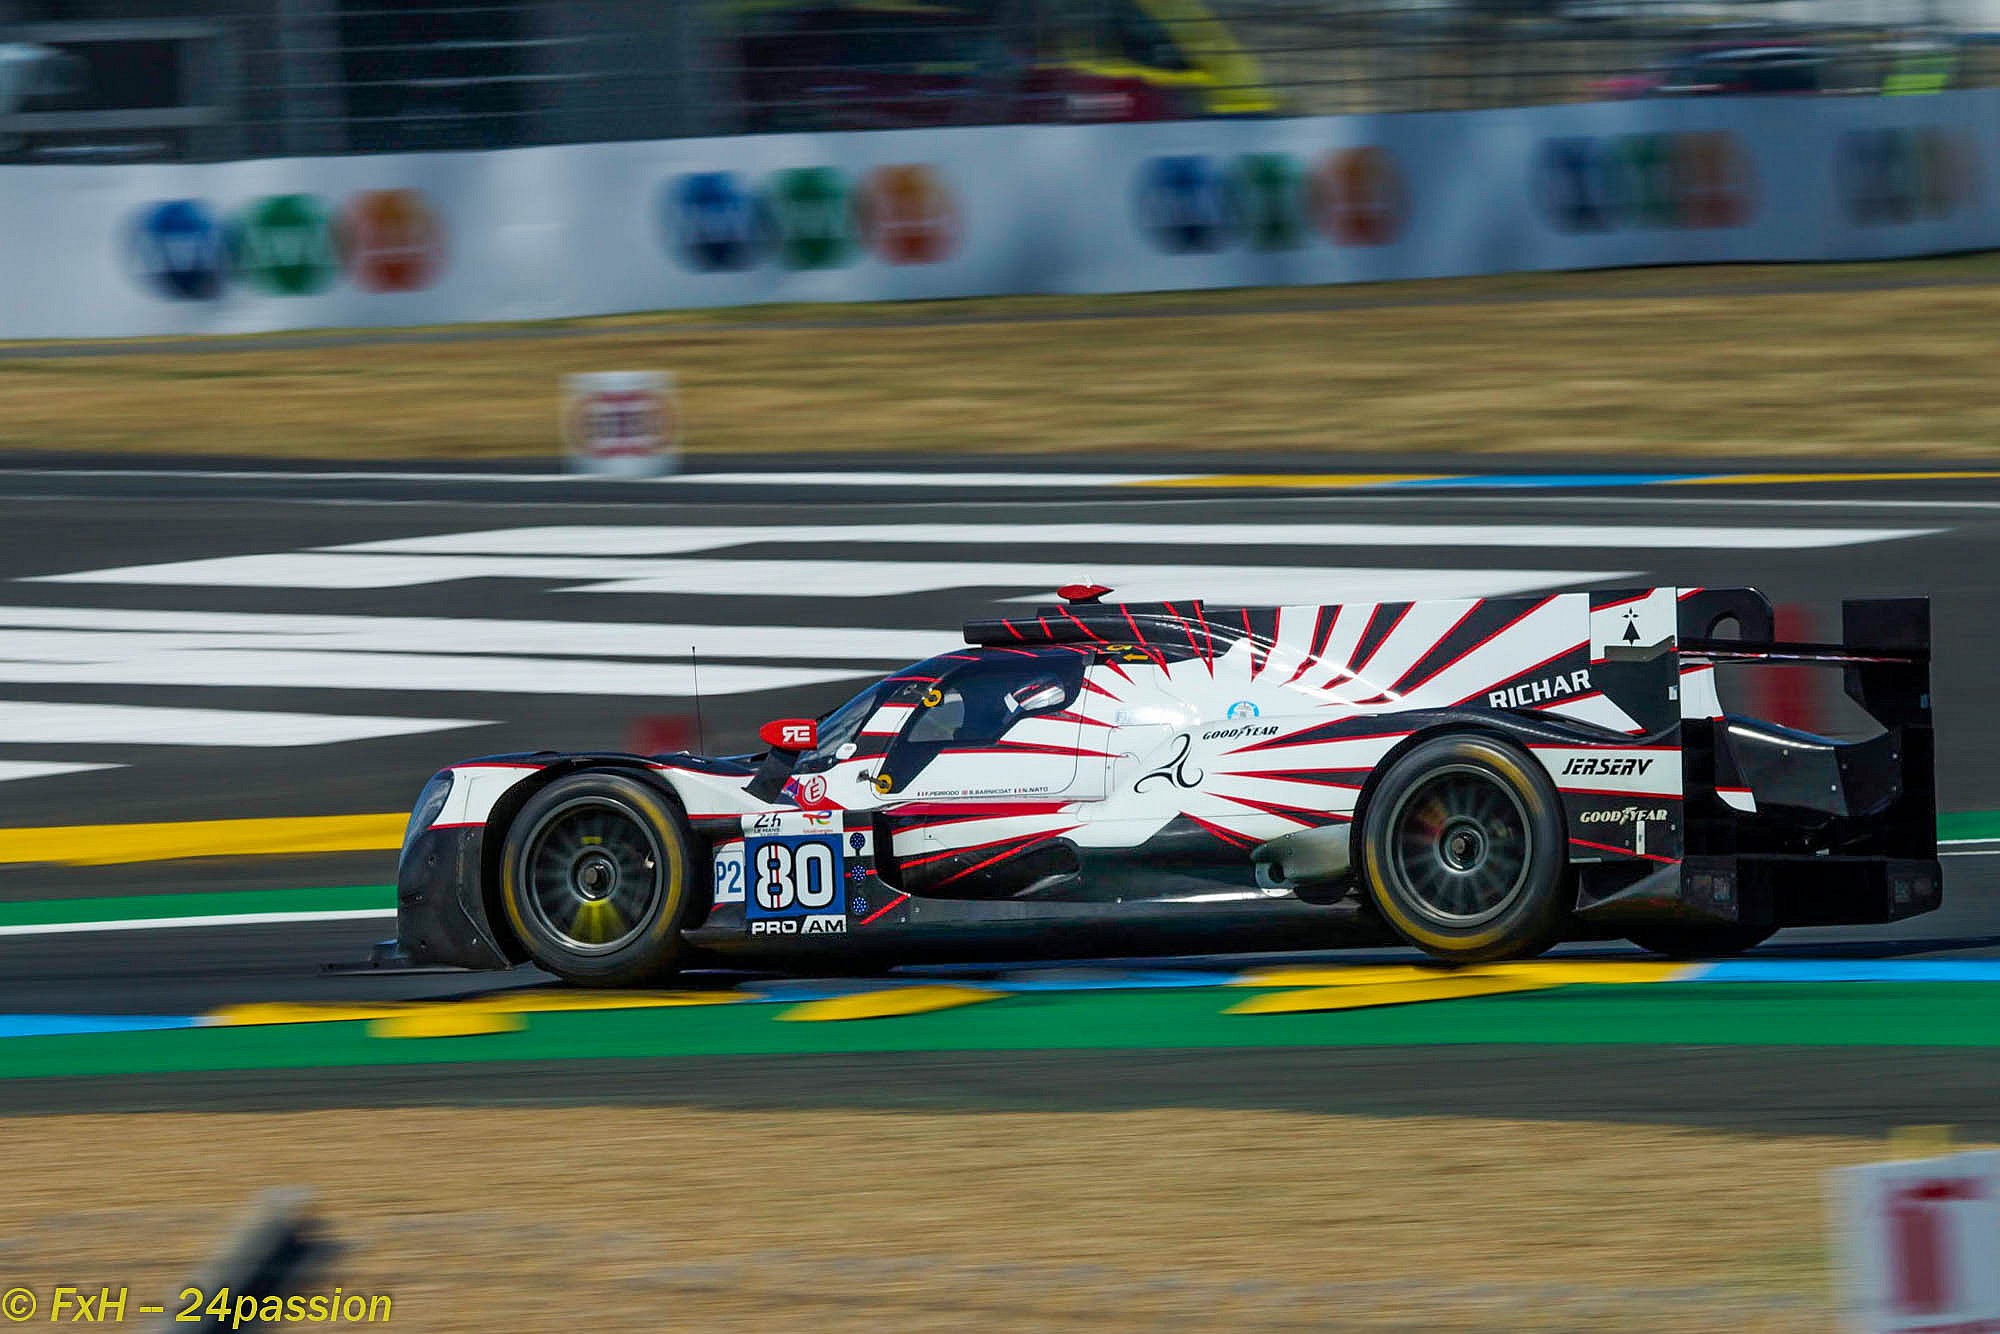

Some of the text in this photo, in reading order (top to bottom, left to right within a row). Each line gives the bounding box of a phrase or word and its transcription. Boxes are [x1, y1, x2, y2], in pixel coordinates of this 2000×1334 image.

[1488, 669, 1592, 708] RICHAR
[1202, 724, 1279, 740] GOODYEAR
[1561, 758, 1654, 775] JERSERV
[1580, 806, 1668, 825] GOODYEAR
[716, 860, 742, 895] P2
[756, 843, 834, 909] 80
[751, 919, 844, 934] PRO AM
